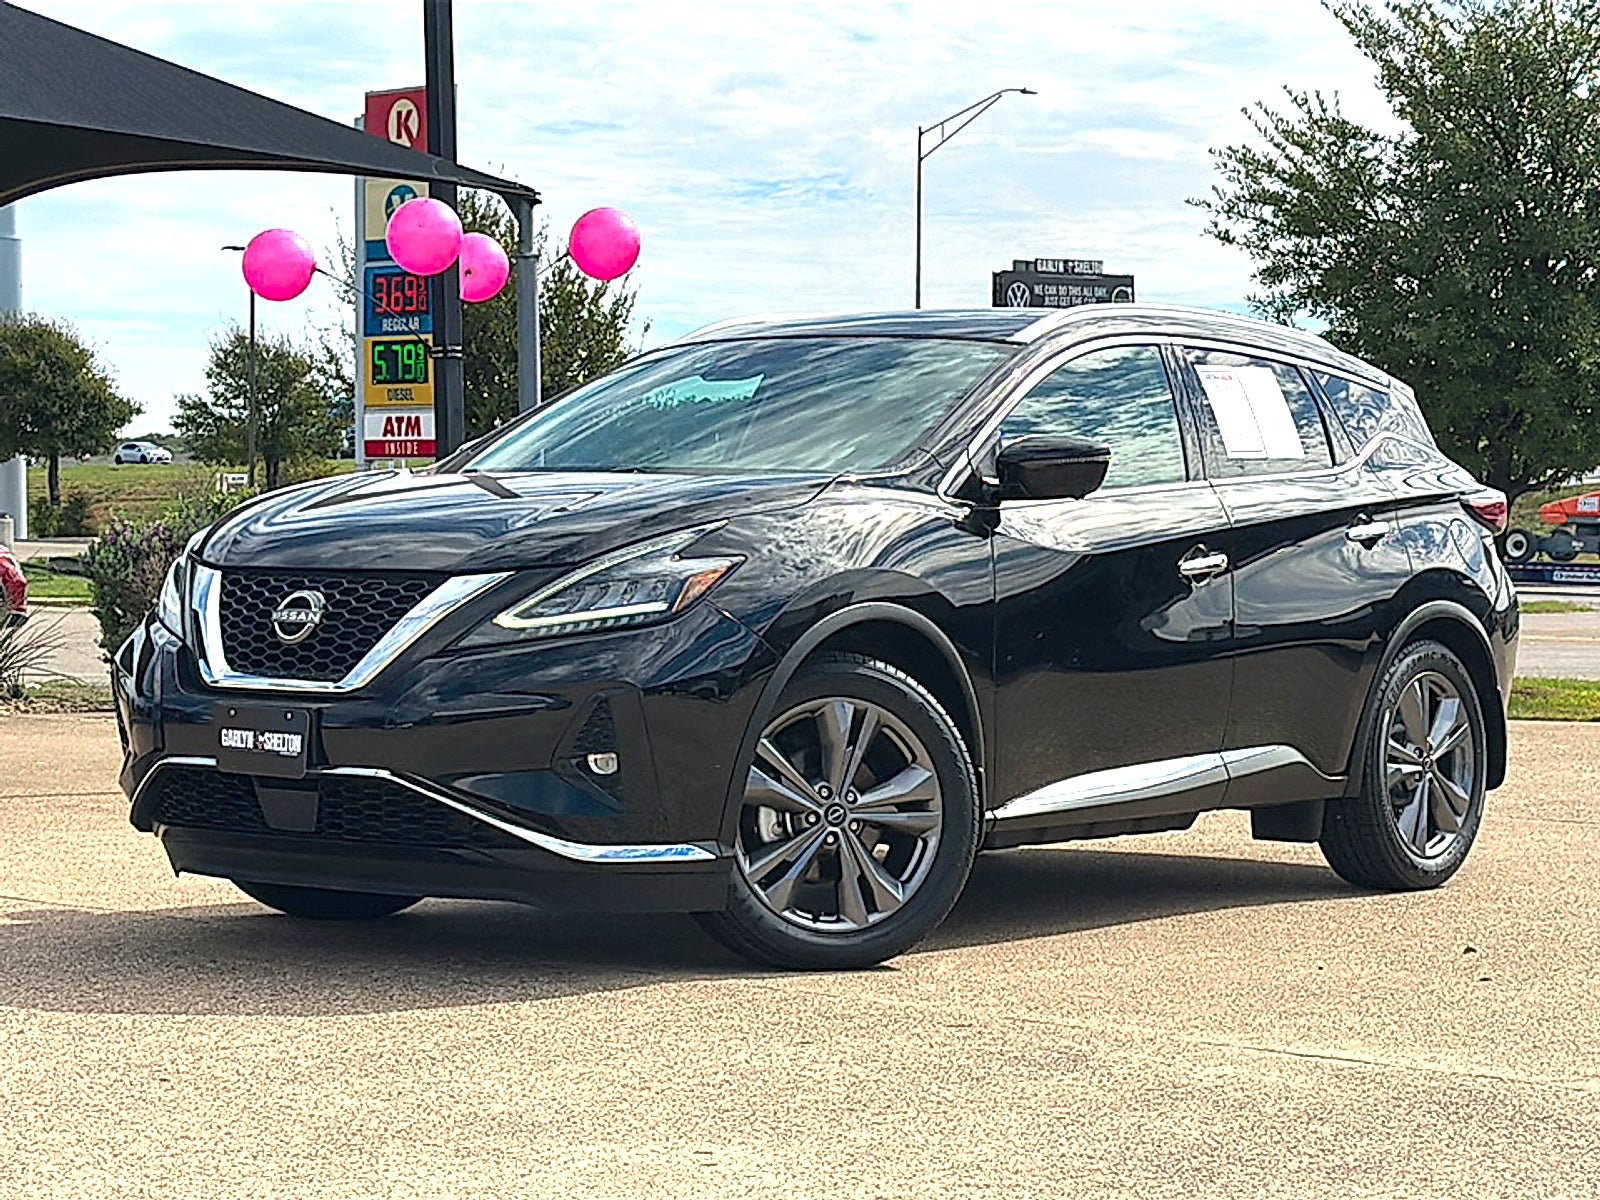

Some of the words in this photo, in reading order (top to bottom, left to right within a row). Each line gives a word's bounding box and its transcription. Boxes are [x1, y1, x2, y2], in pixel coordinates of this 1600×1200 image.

[396, 109, 414, 141] K
[1058, 284, 1067, 296] DO
[383, 416, 422, 437] ATM
[384, 442, 418, 455] INSIDE
[272, 611, 320, 624] NISSAN
[263, 732, 302, 753] SHELTON
